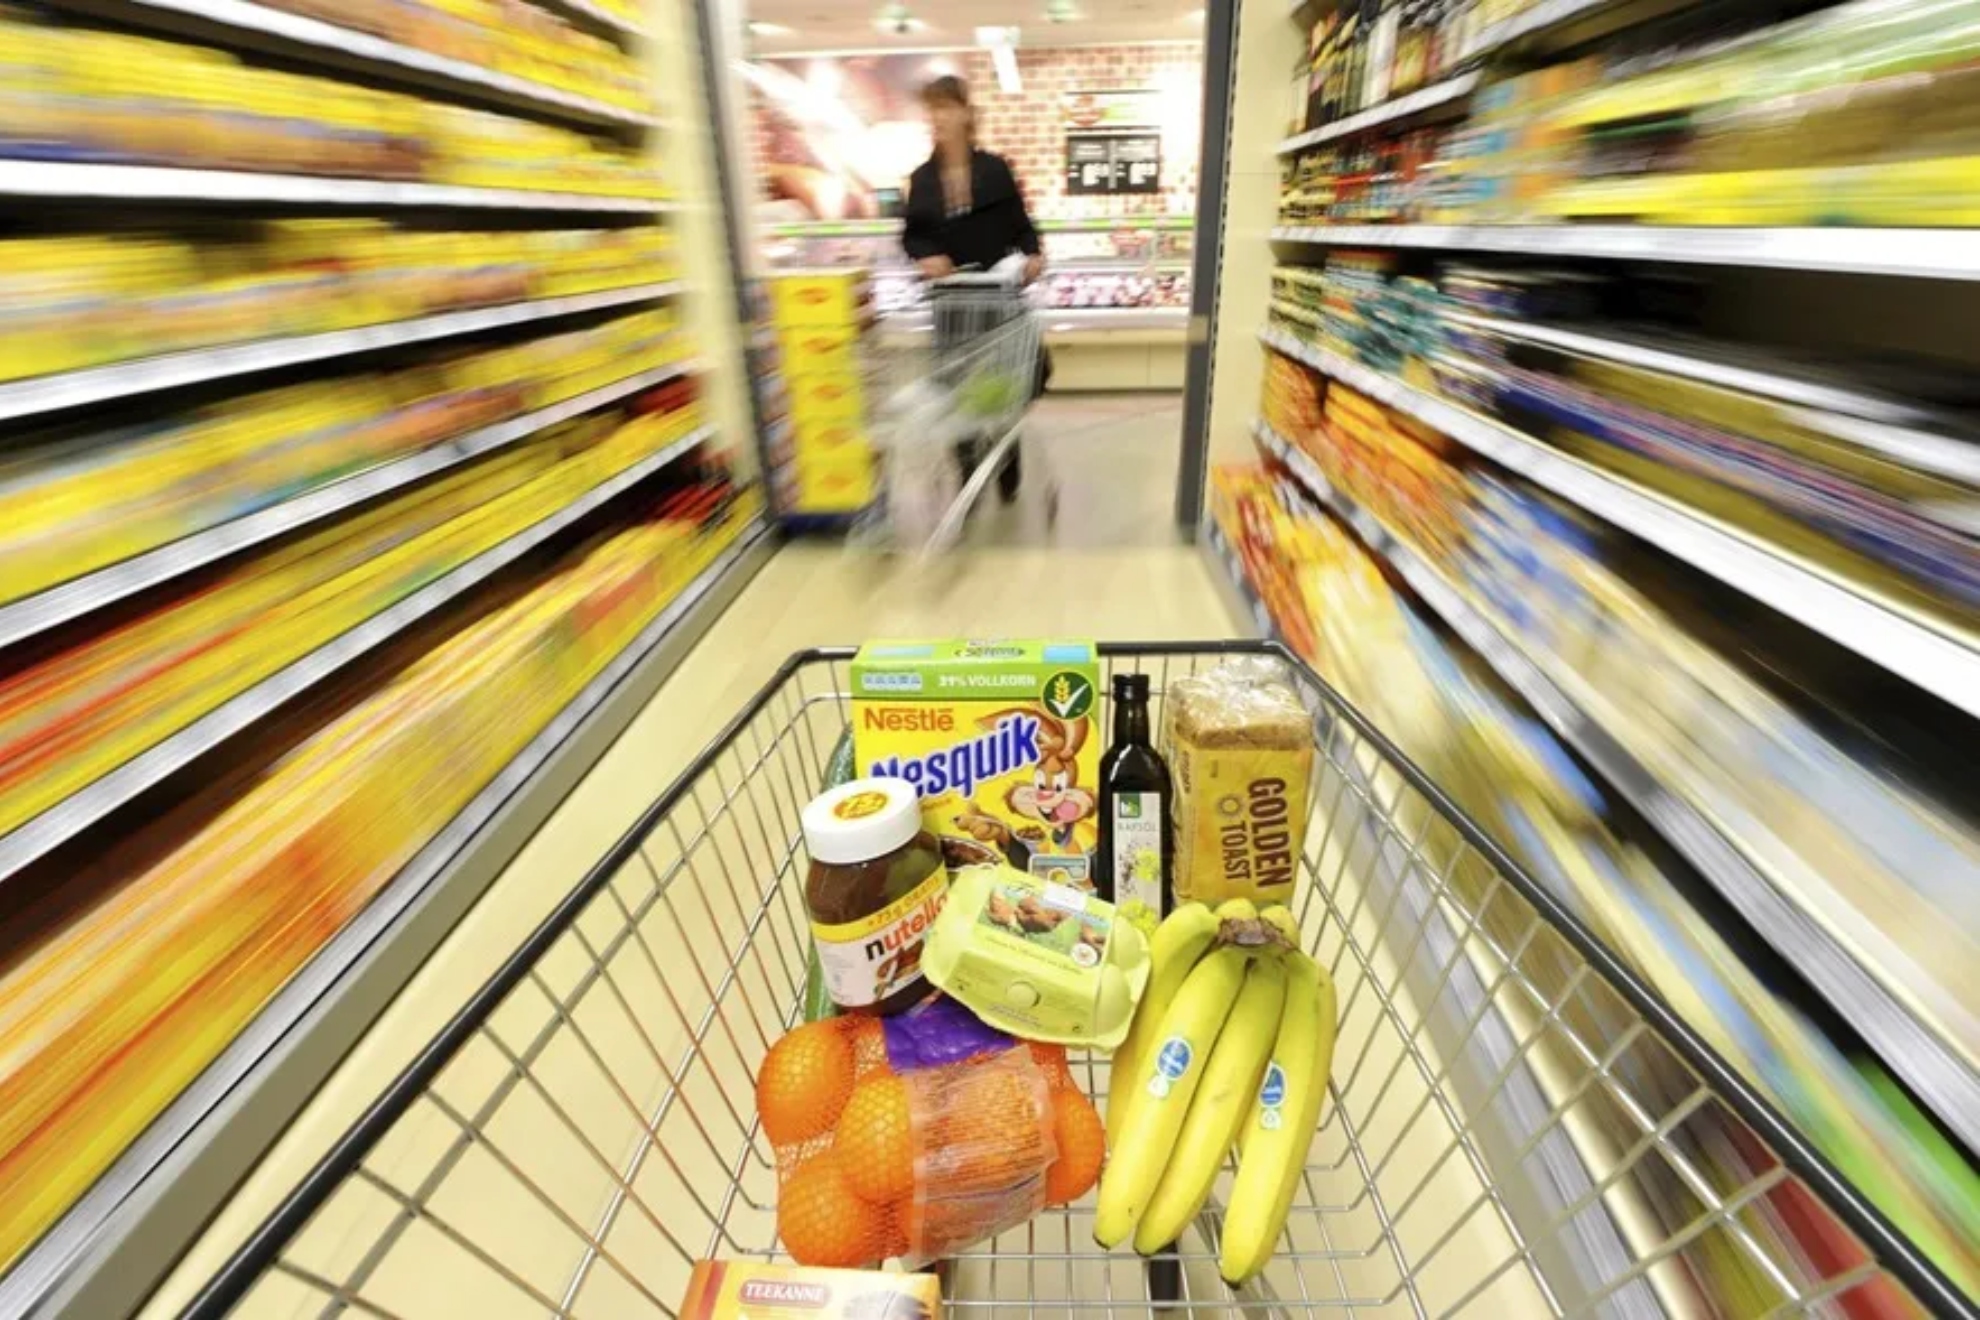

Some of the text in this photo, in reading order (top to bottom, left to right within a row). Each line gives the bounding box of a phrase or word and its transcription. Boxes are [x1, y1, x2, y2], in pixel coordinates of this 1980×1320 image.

[967, 673, 1036, 687] VOLLKORN
[1220, 820, 1251, 880] TOAST
[1247, 777, 1293, 888] GOLDEN
[745, 1283, 824, 1302] TEEKANNE
